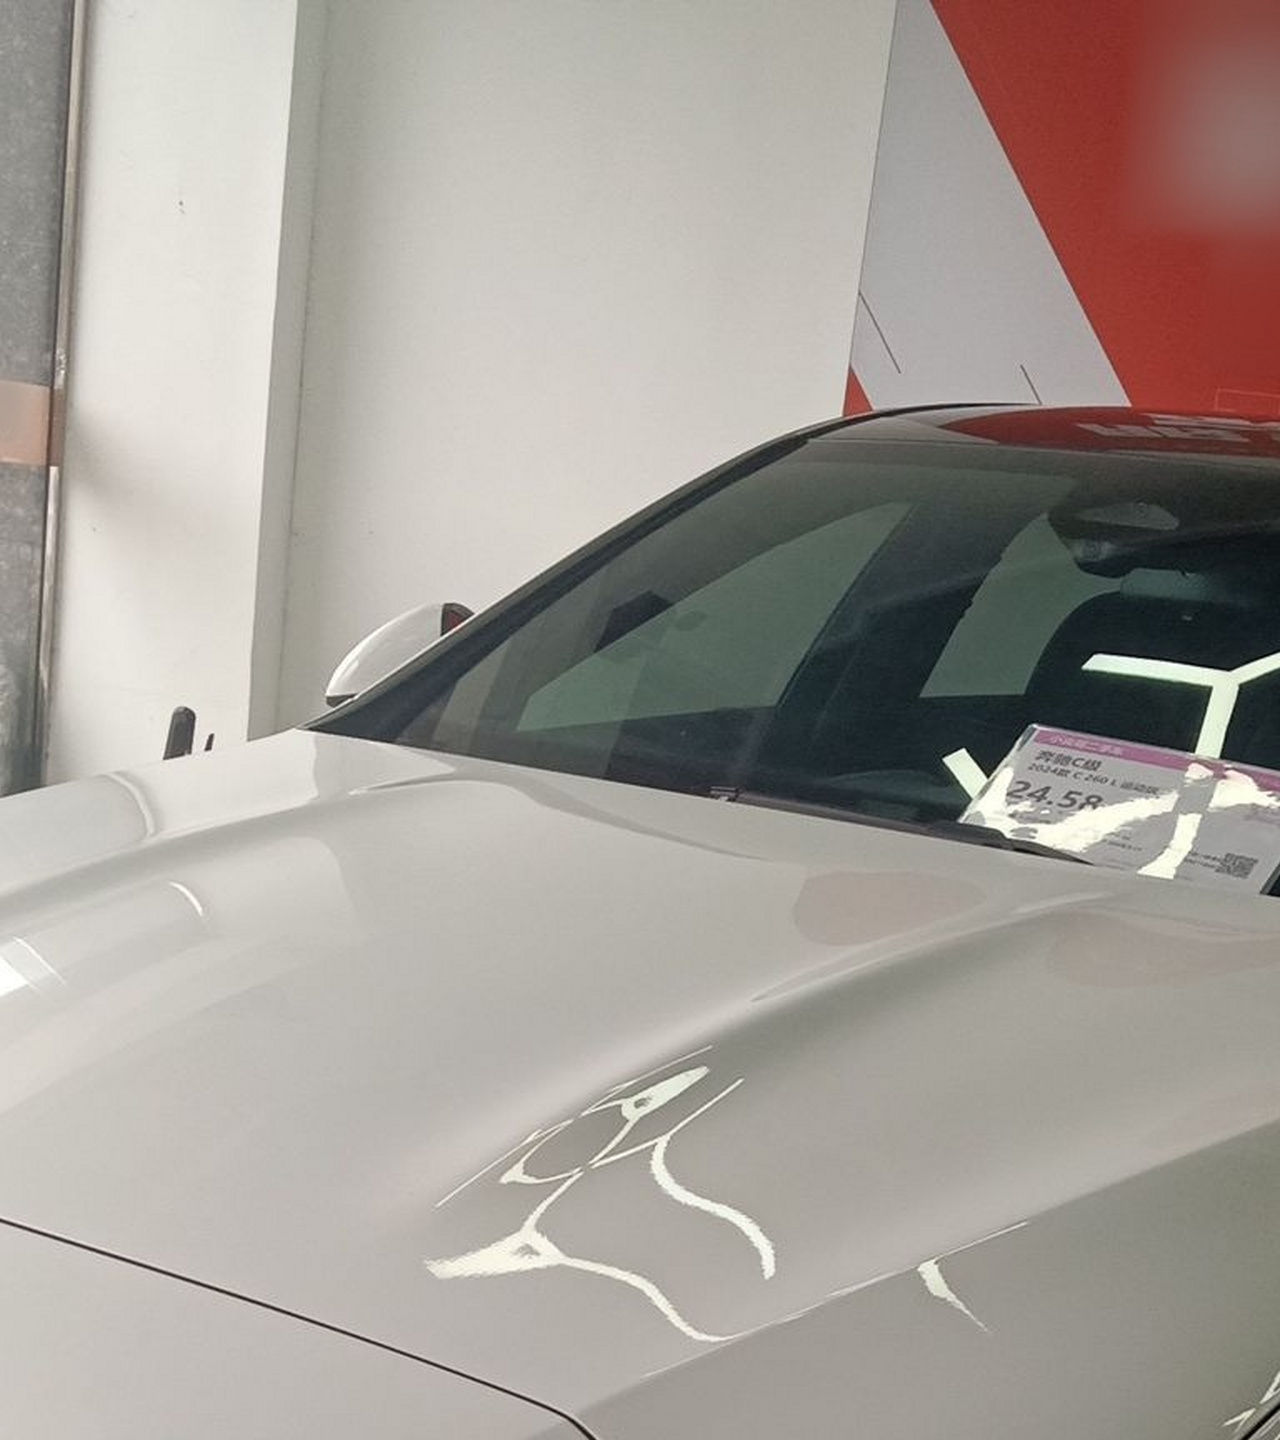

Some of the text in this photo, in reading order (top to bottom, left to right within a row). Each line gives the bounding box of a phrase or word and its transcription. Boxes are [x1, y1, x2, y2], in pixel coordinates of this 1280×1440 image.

[1034, 750, 1103, 771] 奔驰C级
[1072, 770, 1082, 781] C
[1083, 773, 1109, 785] 260
[1007, 780, 1103, 810] 24.58
